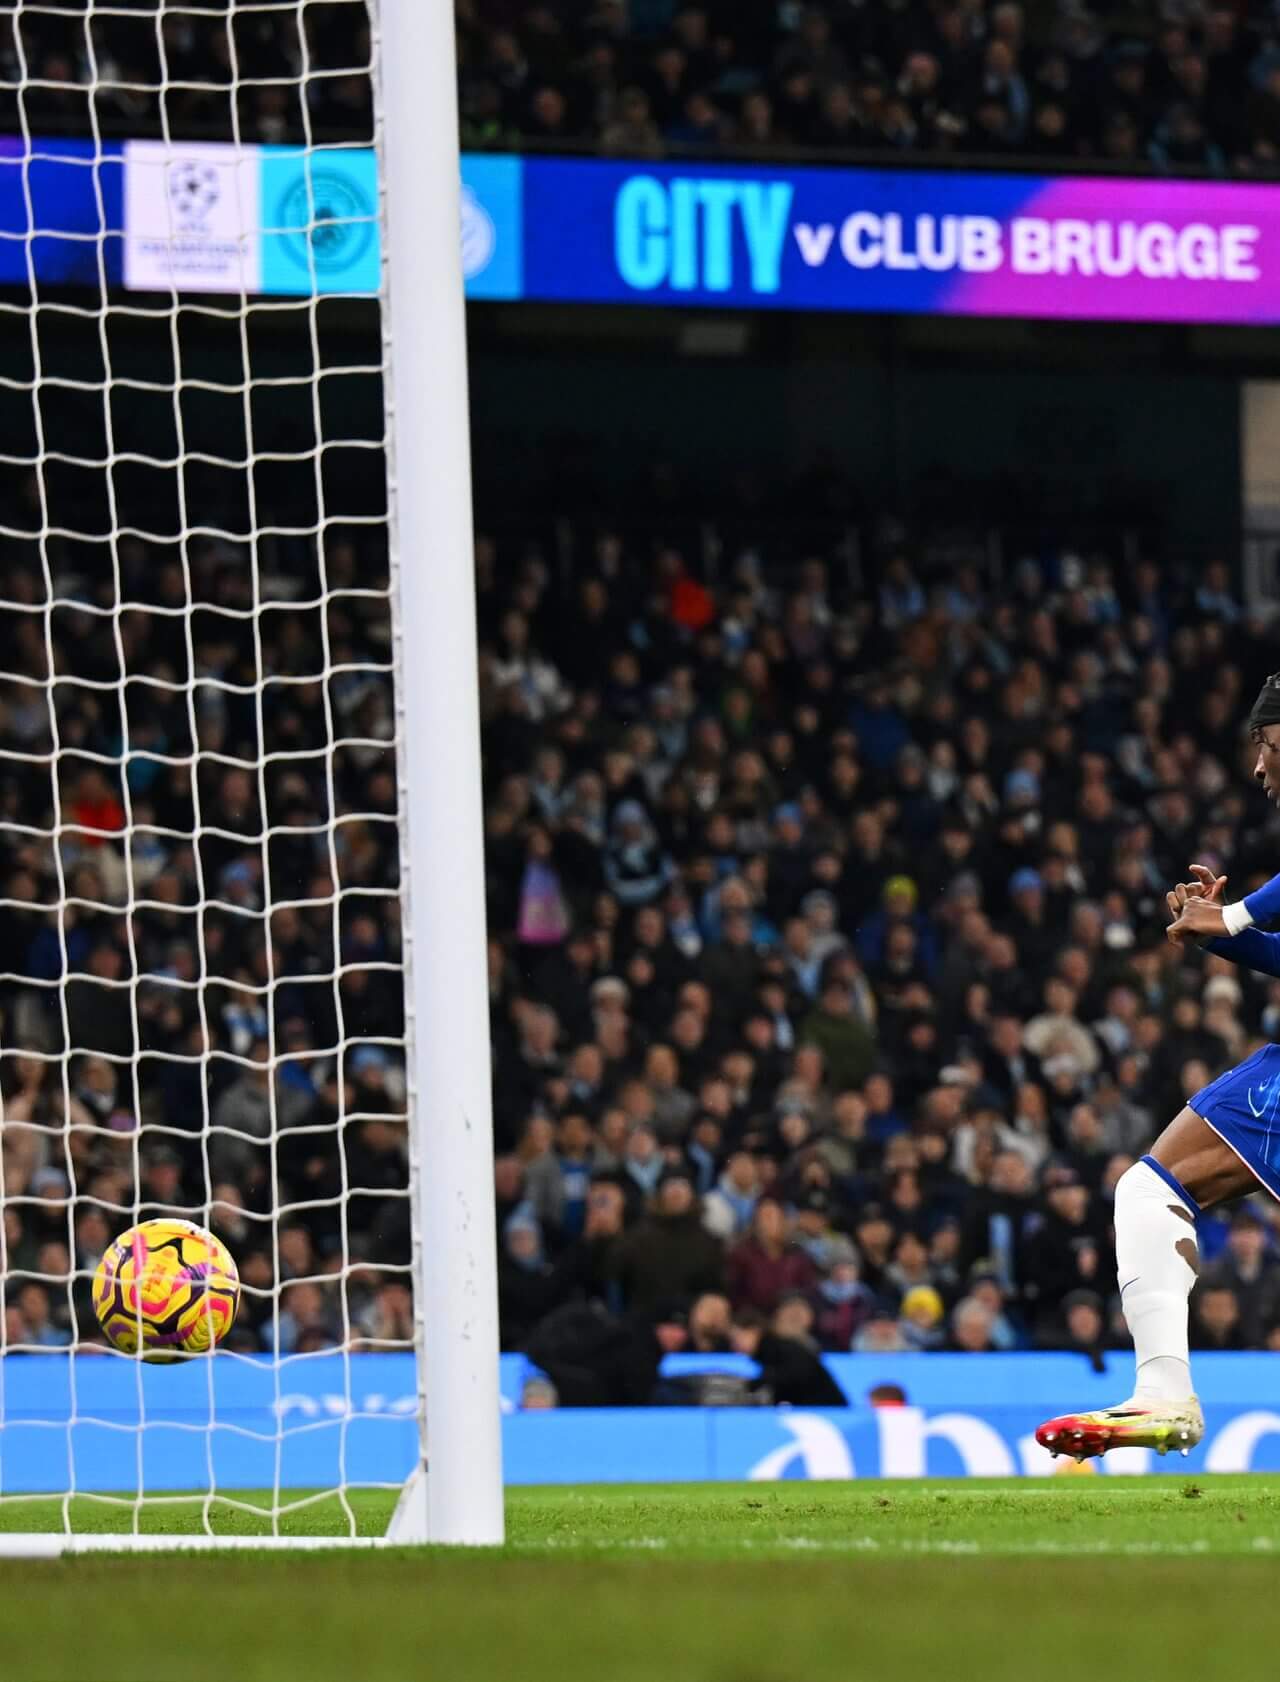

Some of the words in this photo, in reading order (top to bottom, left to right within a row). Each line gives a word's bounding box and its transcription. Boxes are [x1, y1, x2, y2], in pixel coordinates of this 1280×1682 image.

[615, 175, 793, 293] CITY
[795, 224, 834, 266] v
[839, 211, 1004, 274] CLUB
[1009, 218, 1261, 281] BRUGGE
